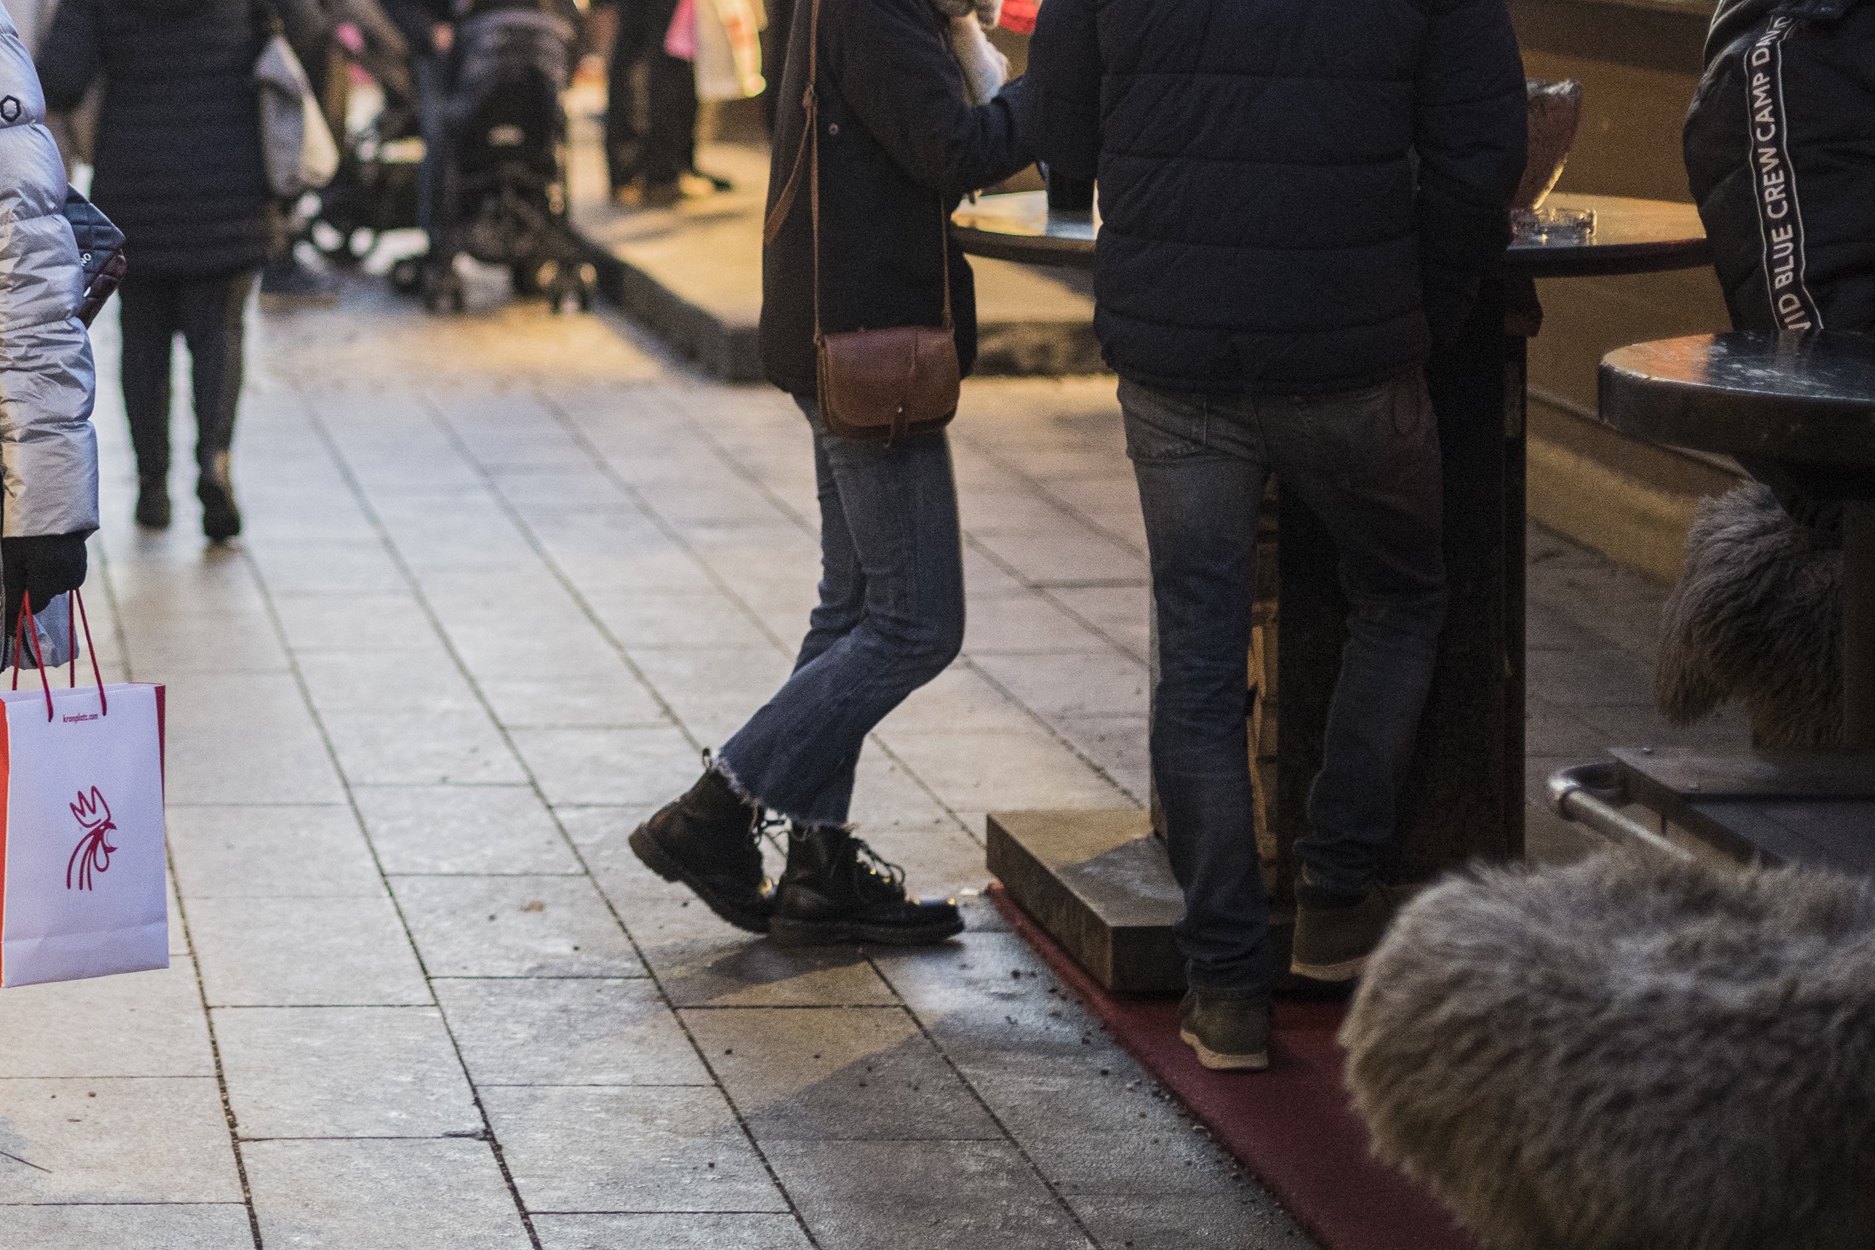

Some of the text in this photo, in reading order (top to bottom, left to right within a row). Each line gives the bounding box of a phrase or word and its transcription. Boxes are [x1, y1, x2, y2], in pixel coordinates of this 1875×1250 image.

[1752, 72, 1776, 142] CAMP
[1758, 147, 1789, 219] CREW
[1771, 224, 1794, 289] BLUE
